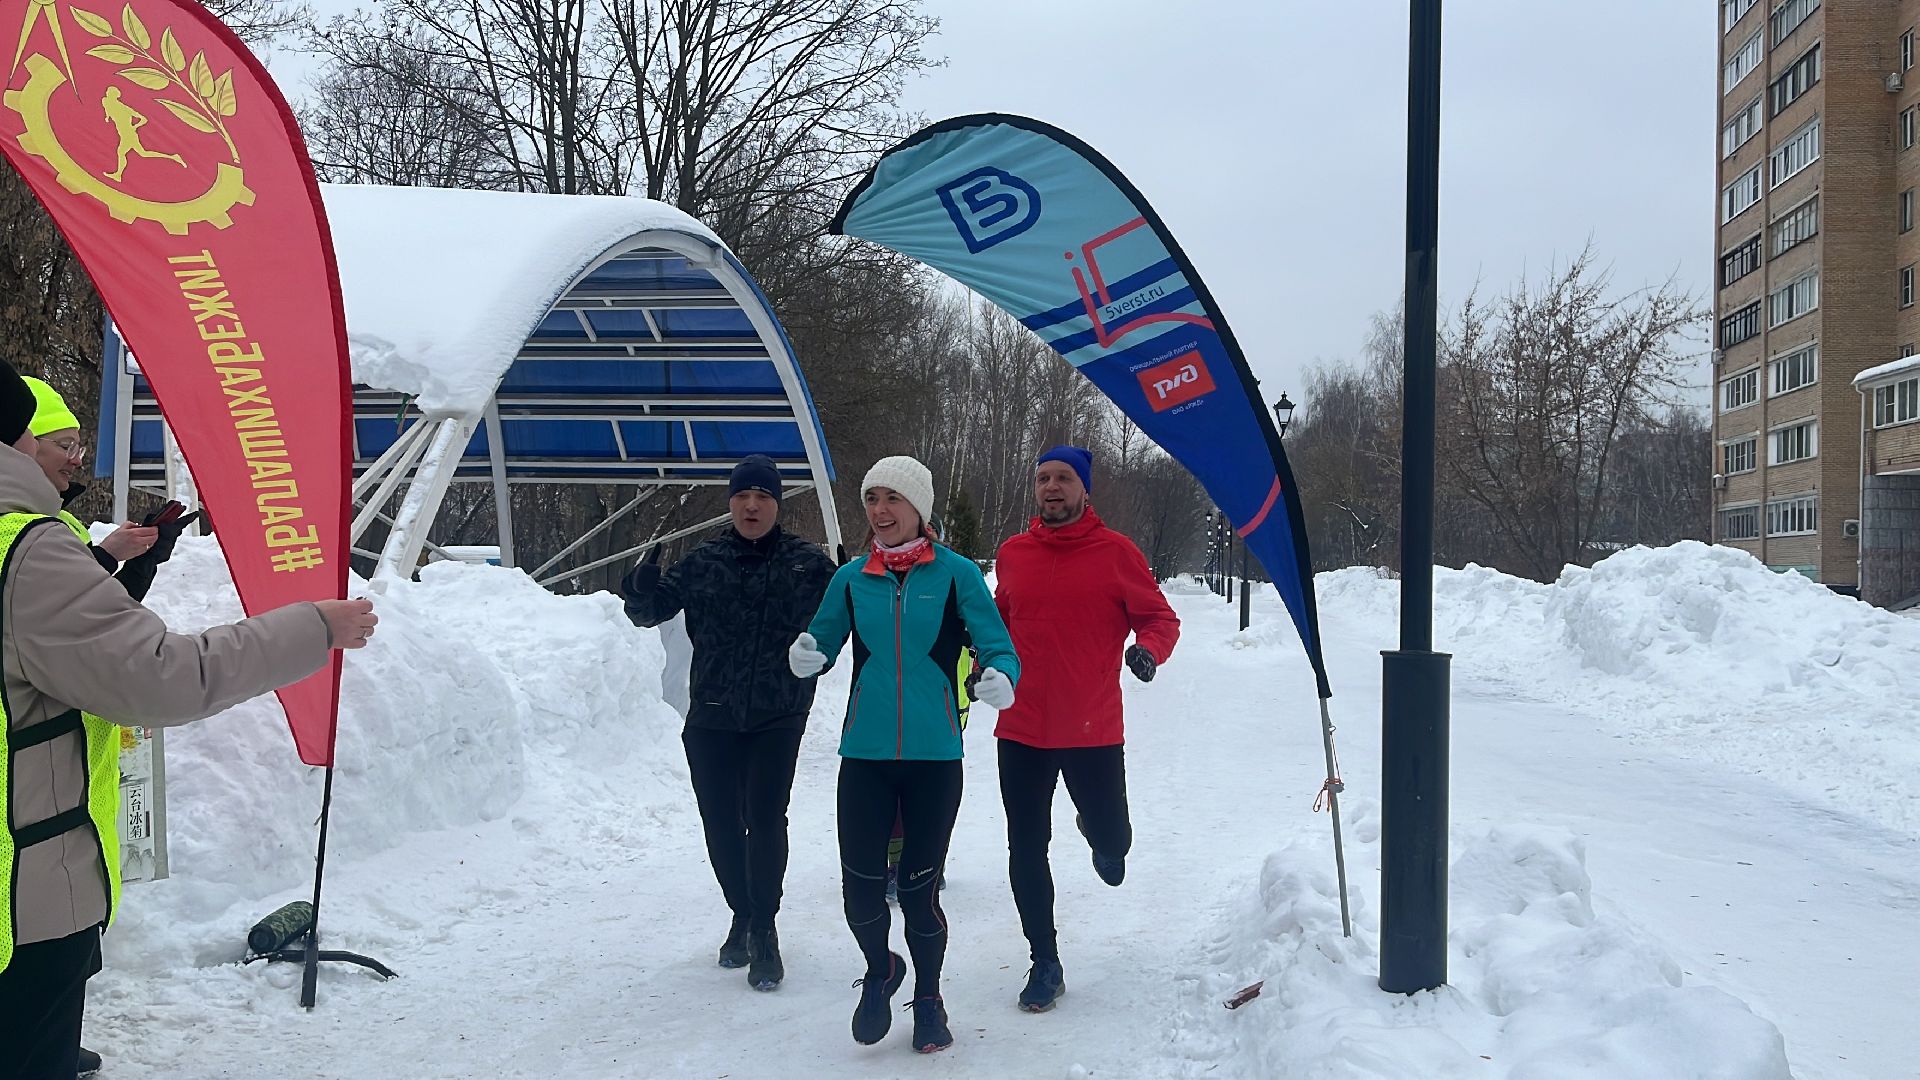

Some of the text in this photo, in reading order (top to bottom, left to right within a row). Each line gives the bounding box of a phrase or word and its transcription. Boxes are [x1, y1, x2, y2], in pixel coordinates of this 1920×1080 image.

[1105, 285, 1165, 319] 5verst.ru
[1173, 340, 1198, 355] ПАРТНЕР
[129, 785, 143, 839] 云台冰菊
